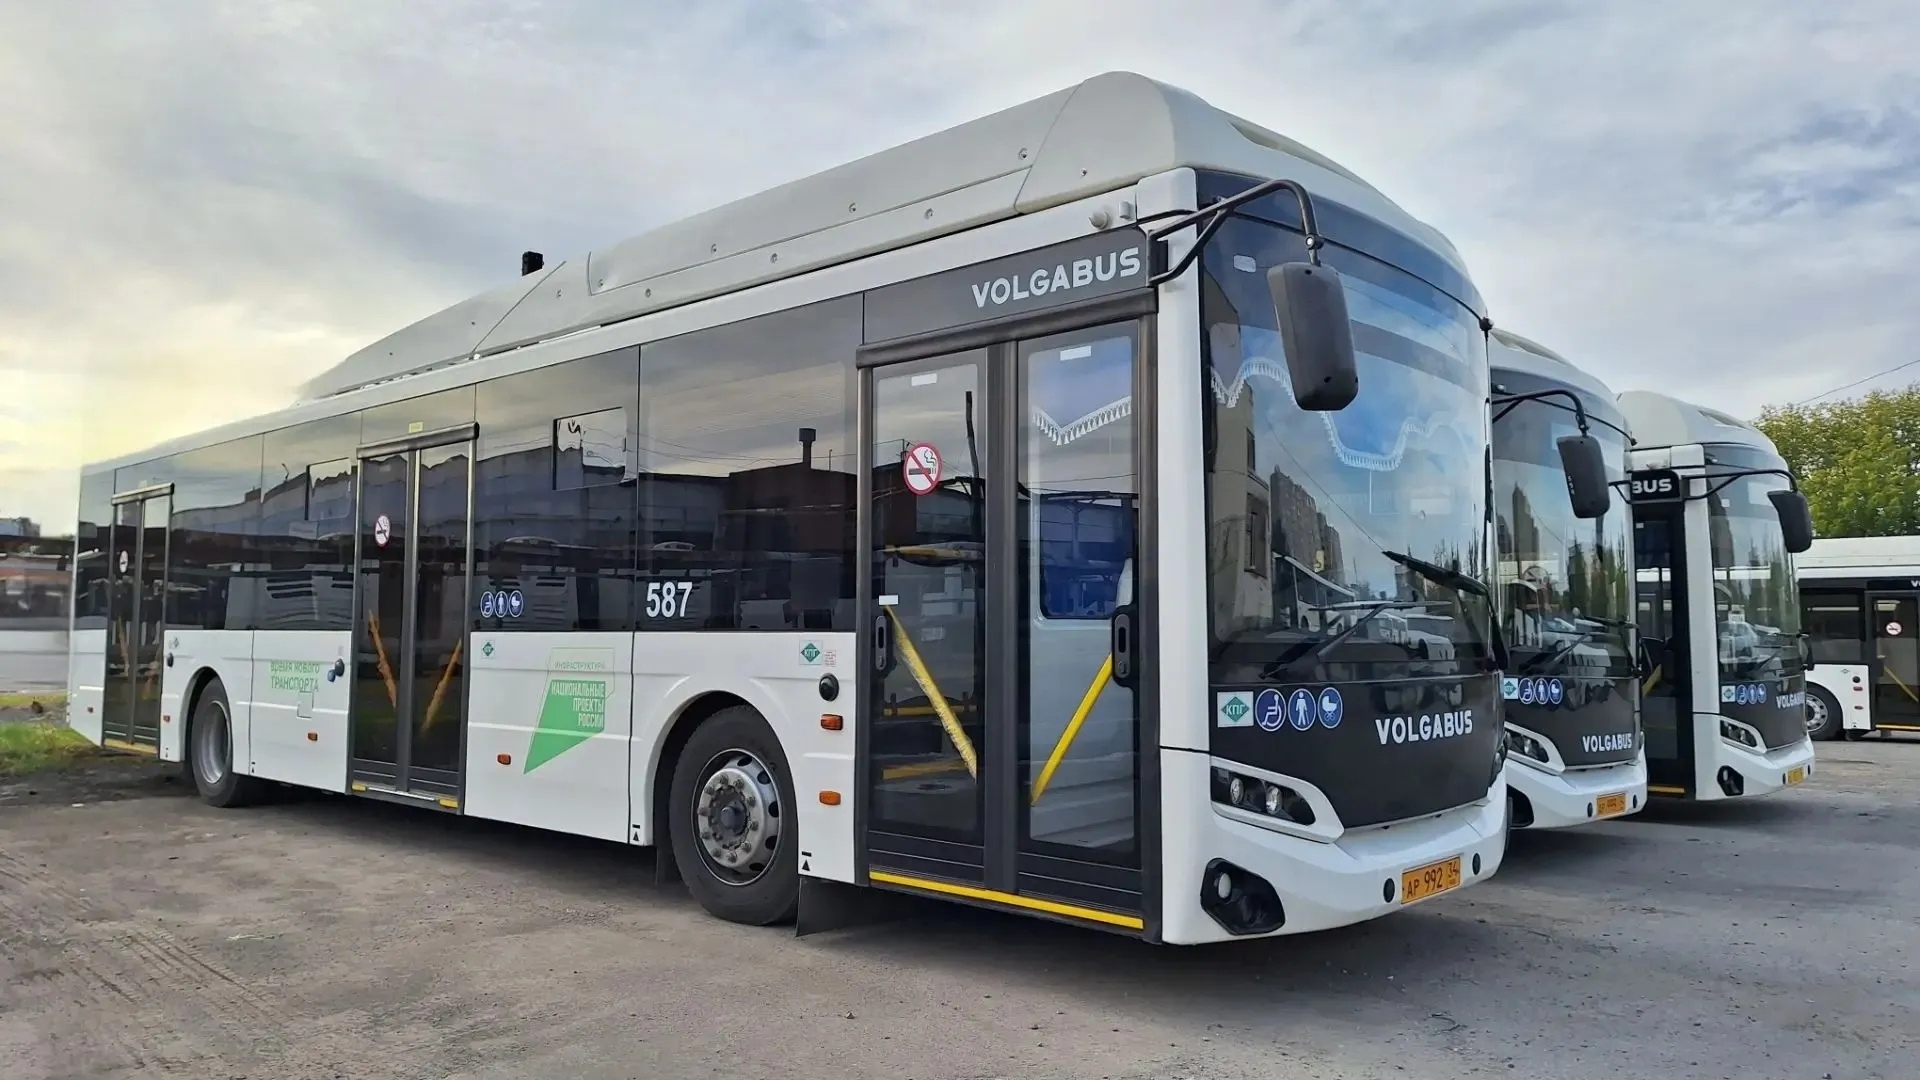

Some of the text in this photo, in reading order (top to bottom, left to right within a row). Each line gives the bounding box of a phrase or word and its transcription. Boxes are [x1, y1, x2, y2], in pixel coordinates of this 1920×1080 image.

[971, 247, 1141, 308] VOLGABUS
[646, 581, 692, 618] 587
[270, 675, 319, 693] ТРАНСПОРТА
[551, 681, 605, 697] НАЦИОНАЛЬНЫЕ
[573, 698, 604, 713] ПРОЕКТЫ
[1226, 704, 1245, 715] КПГ
[578, 713, 604, 728] РОССИИ
[1375, 710, 1472, 745] VOLGABUS
[1582, 732, 1632, 752] VOLGABUS
[1424, 867, 1443, 892] 992
